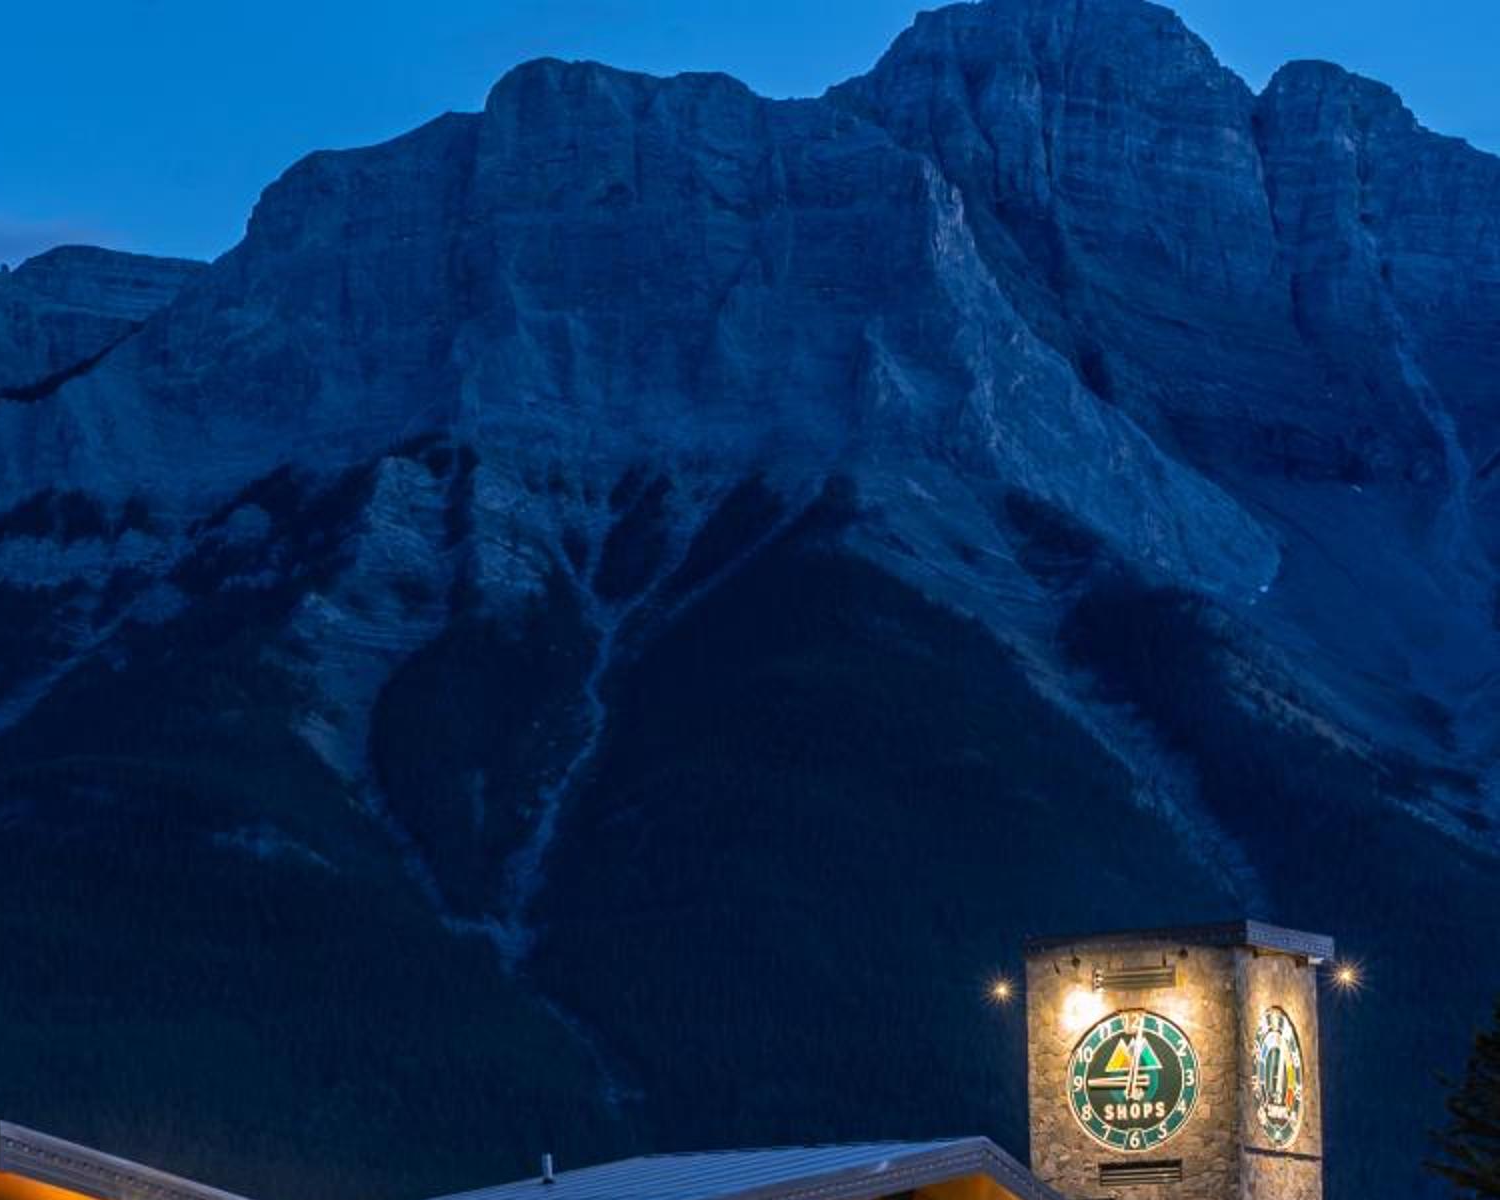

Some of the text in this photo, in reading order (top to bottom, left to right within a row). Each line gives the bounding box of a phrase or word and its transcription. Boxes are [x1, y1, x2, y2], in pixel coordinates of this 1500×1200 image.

[1177, 1040, 1188, 1057] 2
[1073, 1075, 1083, 1092] 9
[1185, 1069, 1195, 1086] 3
[1081, 1103, 1092, 1121] 8
[1104, 1101, 1165, 1120] SHOPS
[1101, 1125, 1112, 1141] 7
[1129, 1131, 1140, 1148] 6
[1158, 1122, 1168, 1140] 5
